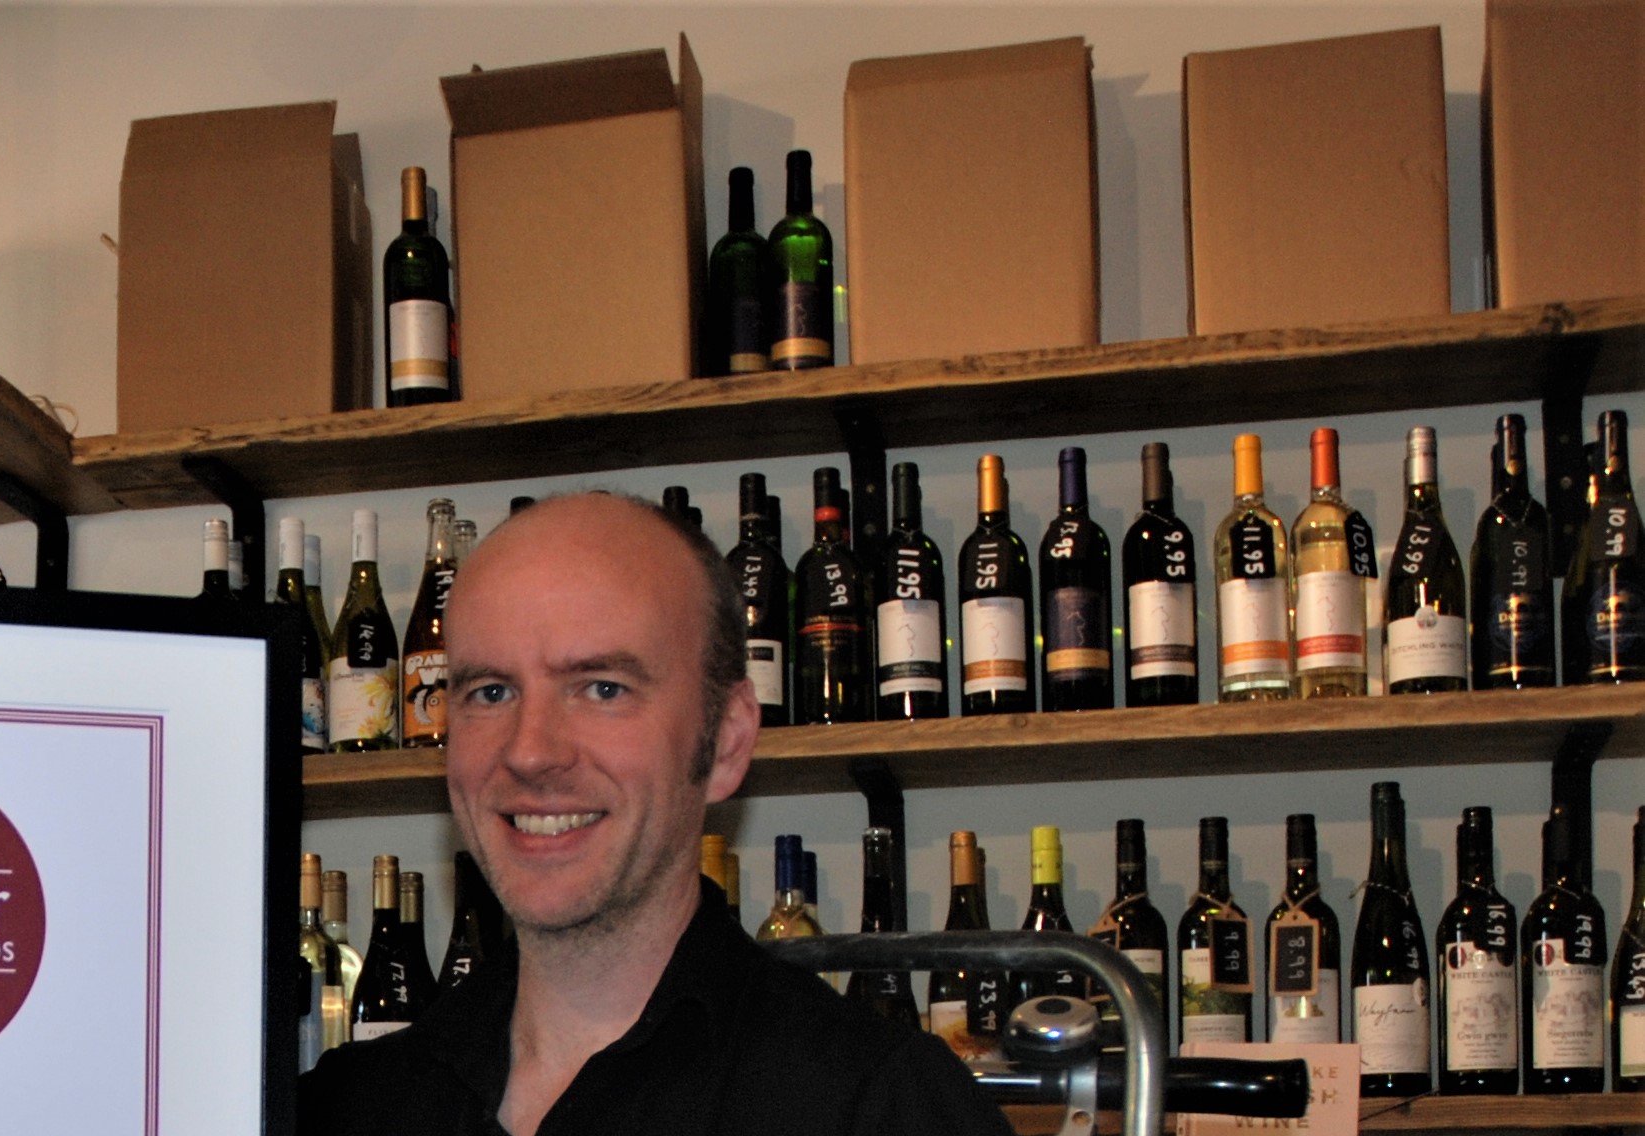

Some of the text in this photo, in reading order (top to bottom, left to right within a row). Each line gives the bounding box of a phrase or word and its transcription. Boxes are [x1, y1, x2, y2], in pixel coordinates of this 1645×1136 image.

[1163, 530, 1187, 577] 9.95
[1242, 526, 1265, 575] 11.95
[1350, 523, 1371, 577] 10.95
[1402, 525, 1432, 575] 13.99
[1604, 507, 1627, 557] 10.99
[743, 555, 762, 598] 13.49
[823, 563, 849, 607] 13.99
[895, 548, 921, 599] 11.95
[975, 542, 999, 590] 11.95
[979, 979, 999, 1032] 23.99
